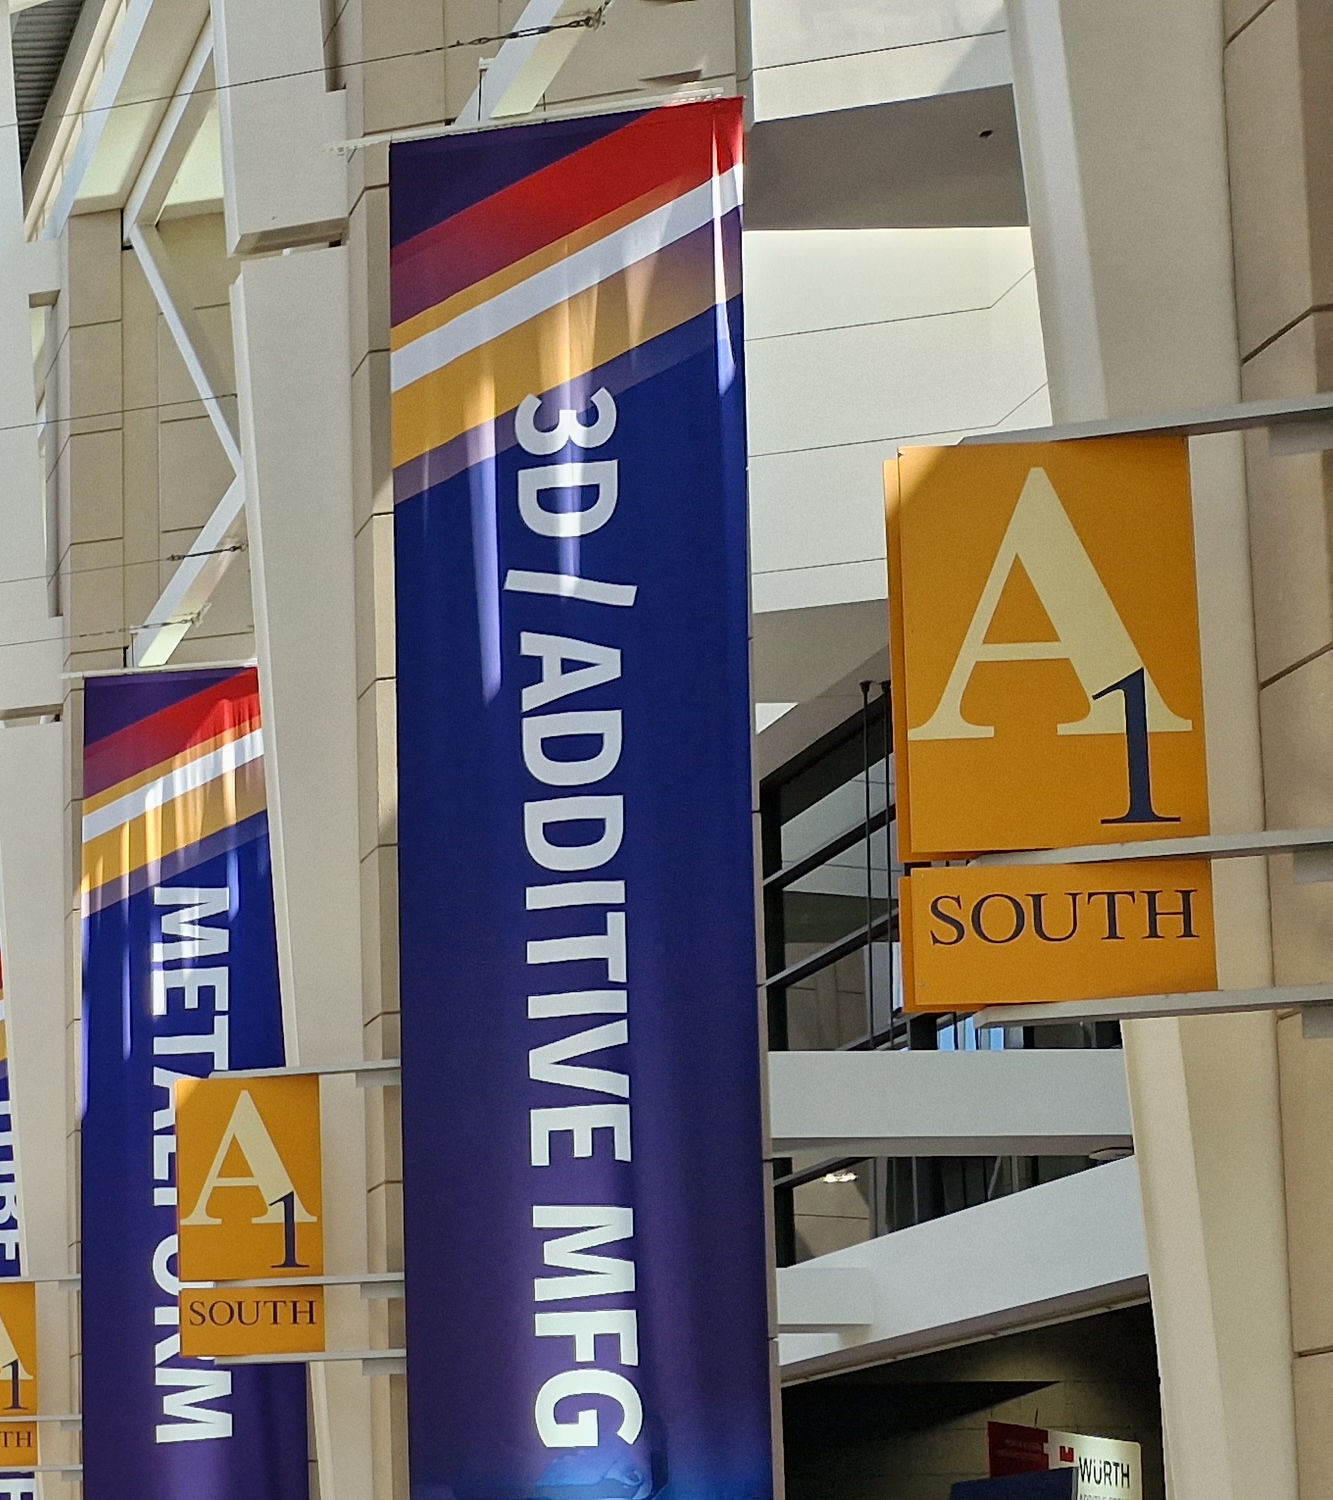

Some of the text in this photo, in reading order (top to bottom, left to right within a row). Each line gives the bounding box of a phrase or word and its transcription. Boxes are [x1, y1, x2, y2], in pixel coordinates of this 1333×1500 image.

[520, 630, 633, 1167] ADDITIVE
[928, 889, 1200, 947] SOUTH
[190, 1299, 319, 1329] SOUTH
[532, 1205, 643, 1448] MFG
